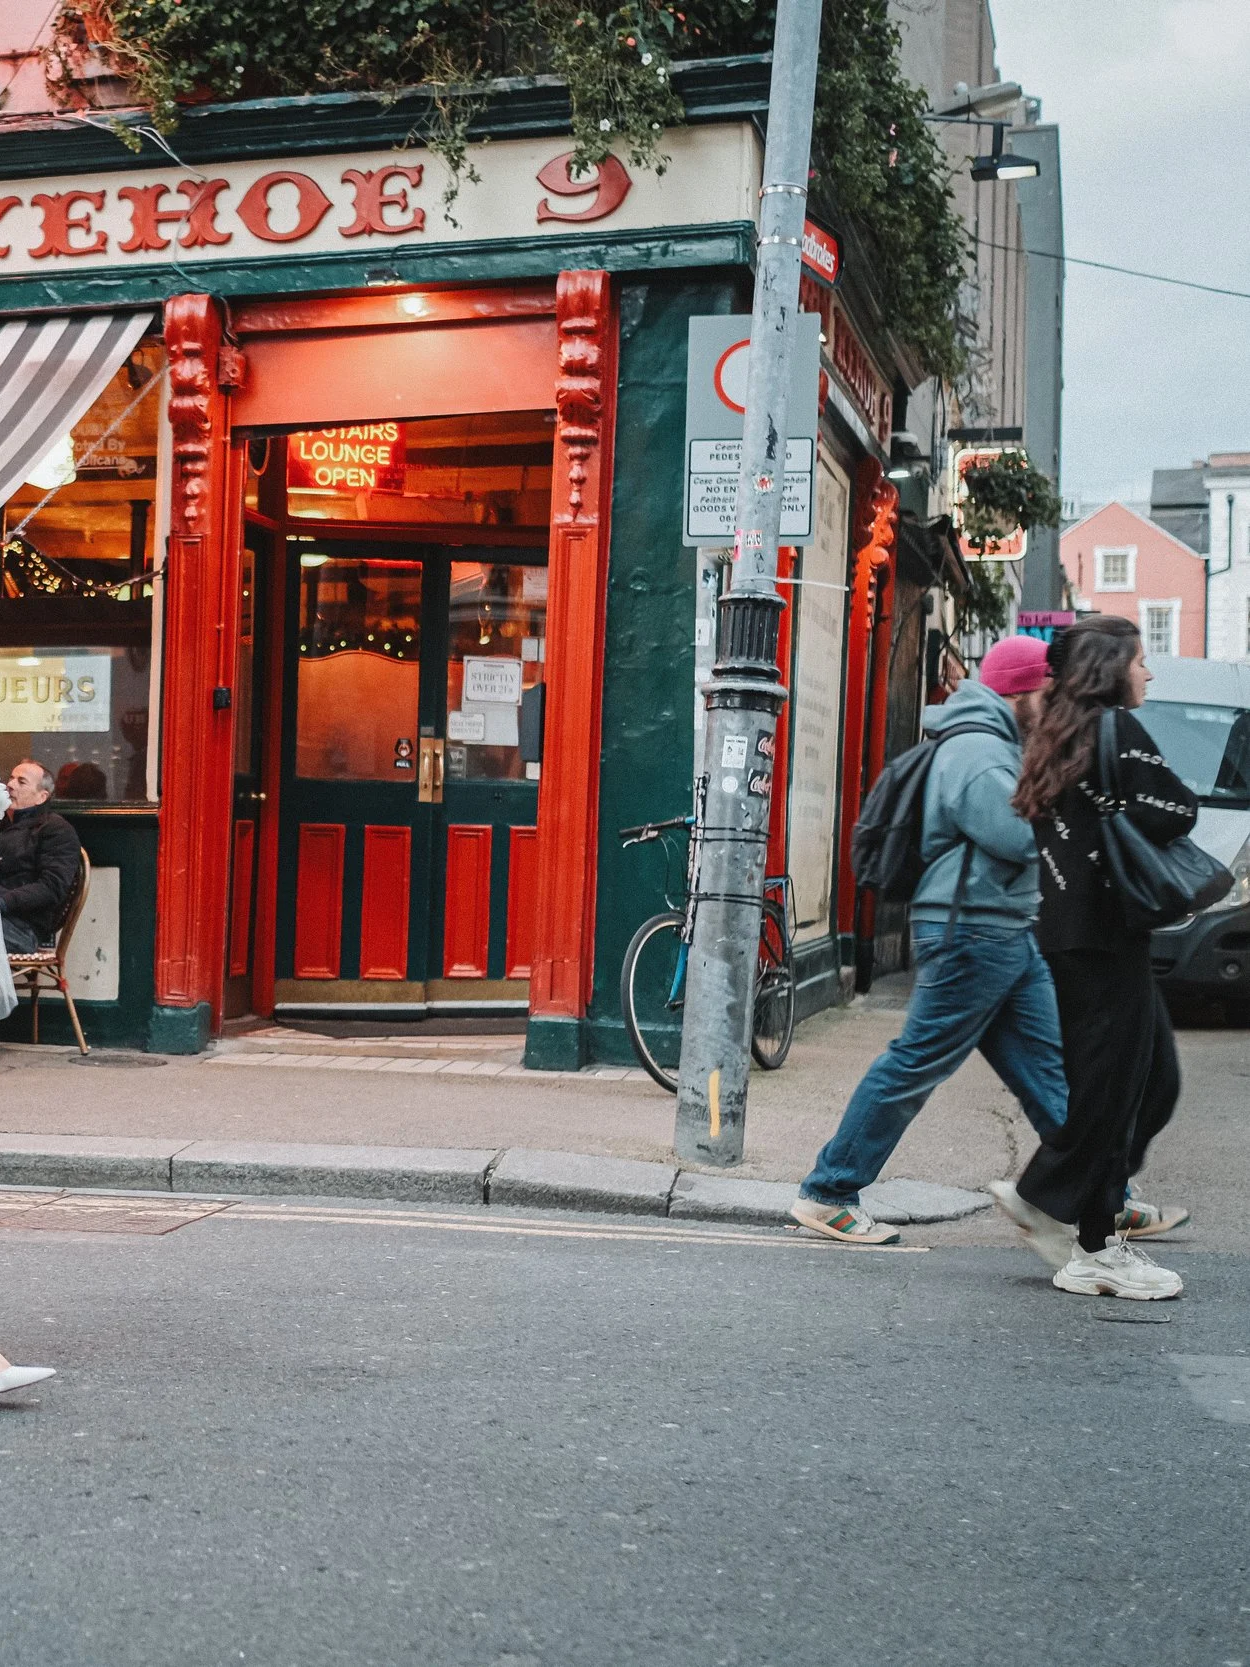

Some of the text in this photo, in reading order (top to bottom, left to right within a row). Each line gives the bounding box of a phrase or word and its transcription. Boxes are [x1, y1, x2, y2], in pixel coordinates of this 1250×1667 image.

[536, 151, 632, 224] 9
[802, 232, 835, 273] adbrokes
[300, 441, 391, 465] LOUNGE
[315, 467, 375, 487] OPEN
